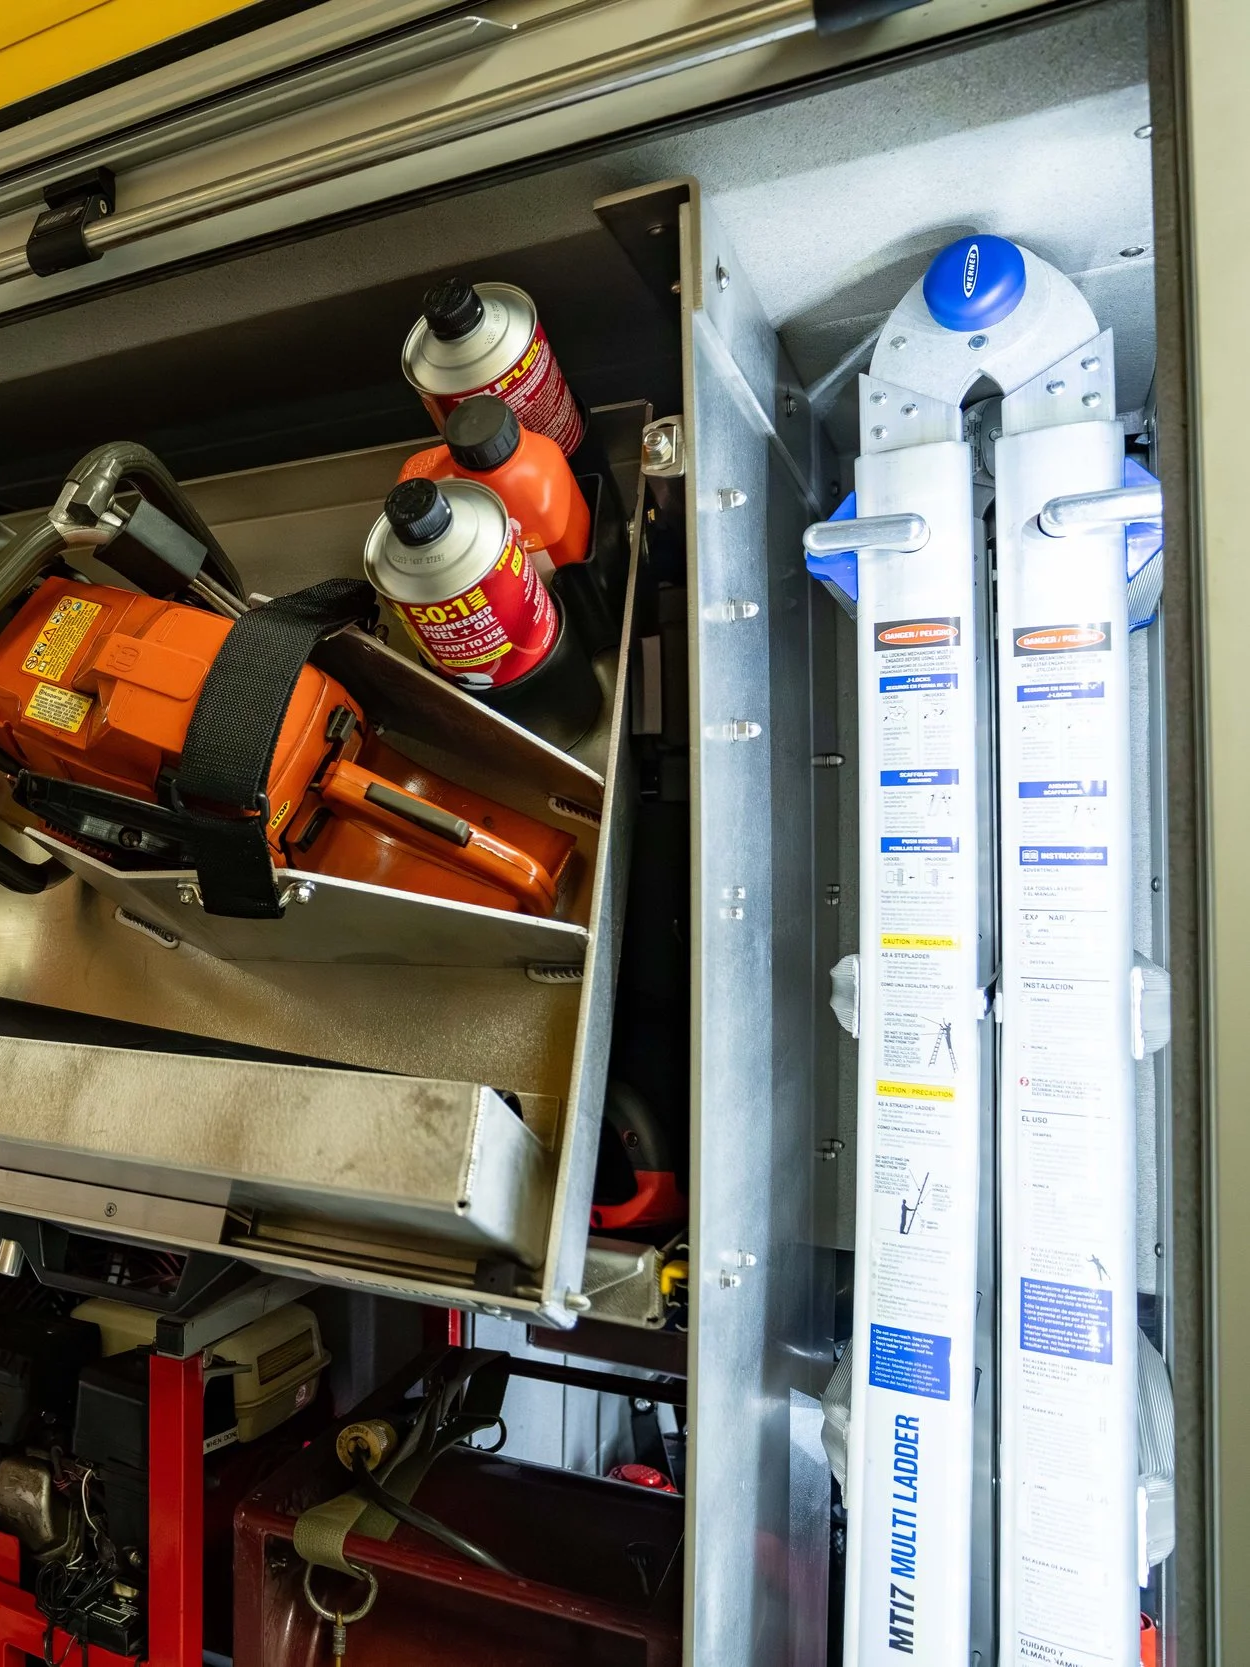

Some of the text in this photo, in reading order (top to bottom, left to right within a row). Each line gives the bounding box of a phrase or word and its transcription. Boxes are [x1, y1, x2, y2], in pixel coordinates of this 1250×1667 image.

[966, 252, 976, 290] WERNER
[410, 587, 489, 624] 50:1 MIX
[420, 606, 493, 633] ENGINEERED
[424, 629, 458, 641] FUEL
[475, 615, 498, 631] OIL
[432, 626, 505, 654] READY TO USE
[451, 649, 479, 658] 2-CYCLE
[480, 636, 508, 653] ENGINES
[886, 632, 915, 640] DANGER
[1024, 637, 1056, 645] DANGER
[451, 649, 502, 664] ETHANOL-FREE
[272, 802, 288, 827] STOP
[879, 1086, 954, 1098] CAUTION PRECAUTION
[889, 1414, 921, 1655] MT17 MULTI LADDER
[1021, 1639, 1057, 1656] CUIDADO
